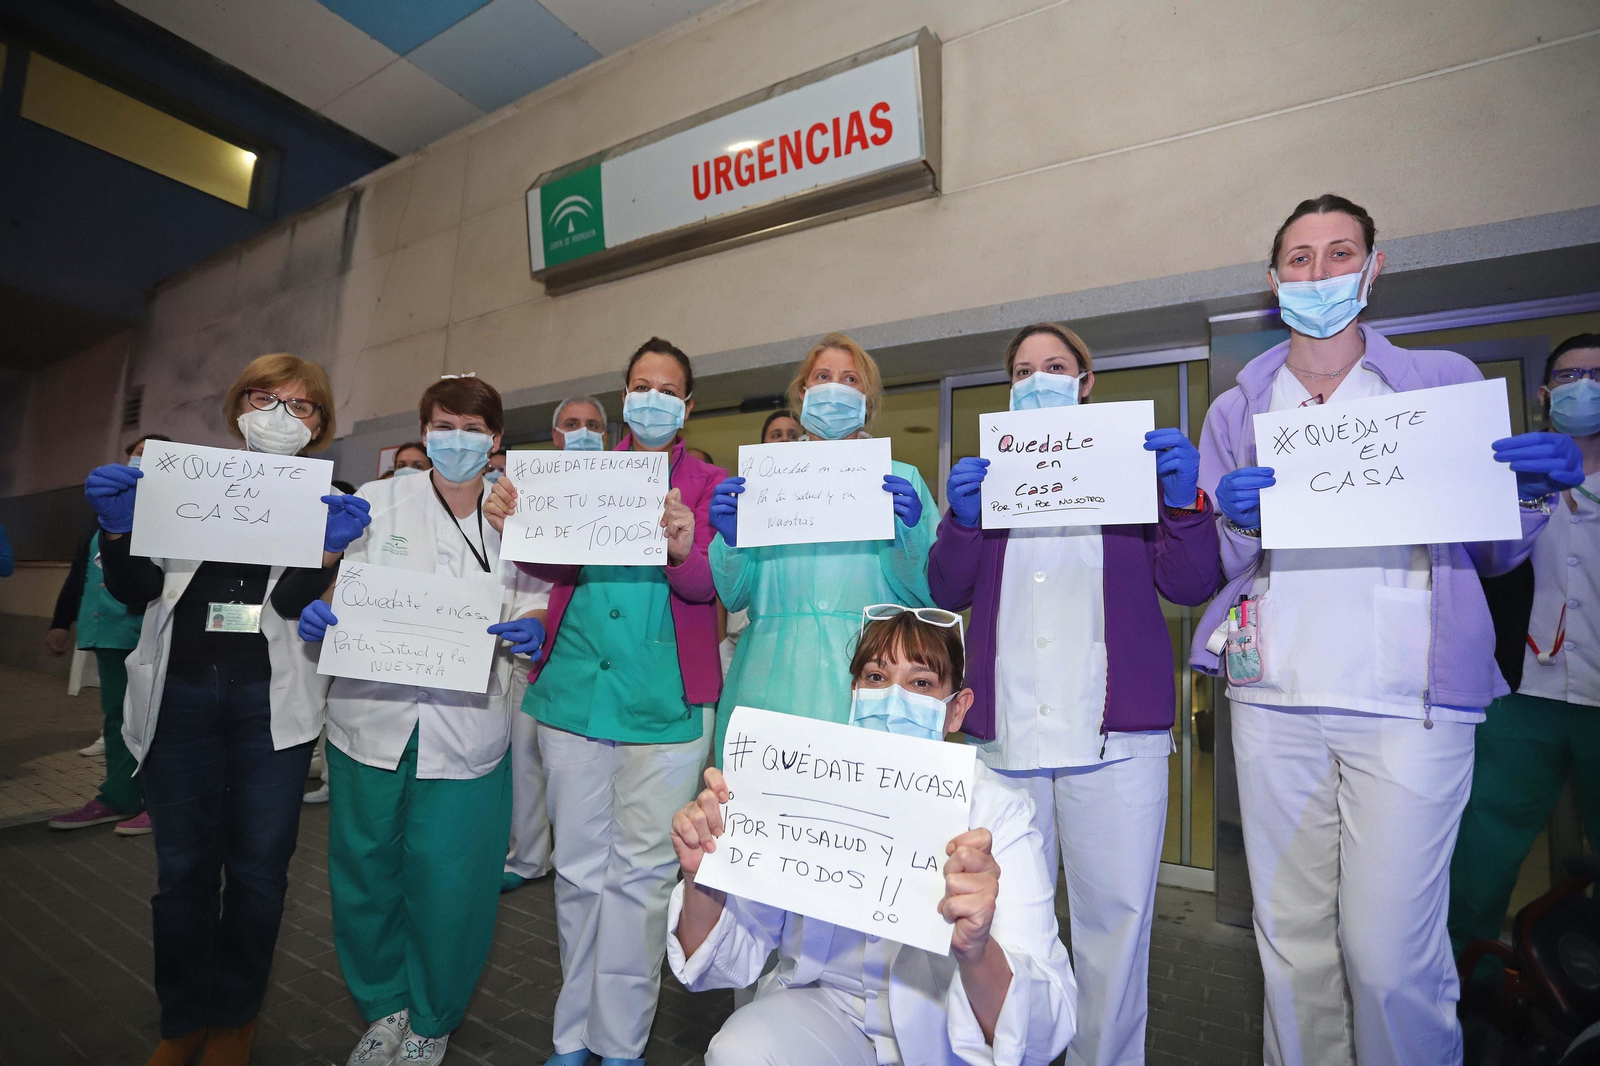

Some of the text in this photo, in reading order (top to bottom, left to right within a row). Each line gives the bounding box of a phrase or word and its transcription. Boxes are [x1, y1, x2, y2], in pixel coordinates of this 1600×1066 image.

[691, 101, 894, 201] URGENCIAS
[1273, 410, 1427, 455] #QUÉDATE
[1359, 442, 1398, 460] EN
[155, 452, 307, 481] #QUÉDATE
[1036, 459, 1062, 470] en
[1309, 465, 1405, 494] CASA
[224, 483, 260, 499] EN
[563, 493, 588, 509] TU
[598, 494, 647, 509] SALUD
[656, 495, 665, 510] Y
[775, 488, 786, 503] tu
[827, 490, 834, 505] y
[175, 502, 271, 525] CASA
[525, 525, 544, 540] LA
[554, 525, 573, 539] DE
[333, 630, 351, 654] Por
[352, 633, 376, 653] tu
[436, 651, 444, 665] y
[451, 647, 466, 664] la
[370, 660, 446, 677] NUESTRA
[729, 846, 762, 868] DE
[880, 845, 894, 867] Y
[911, 850, 938, 872] LA
